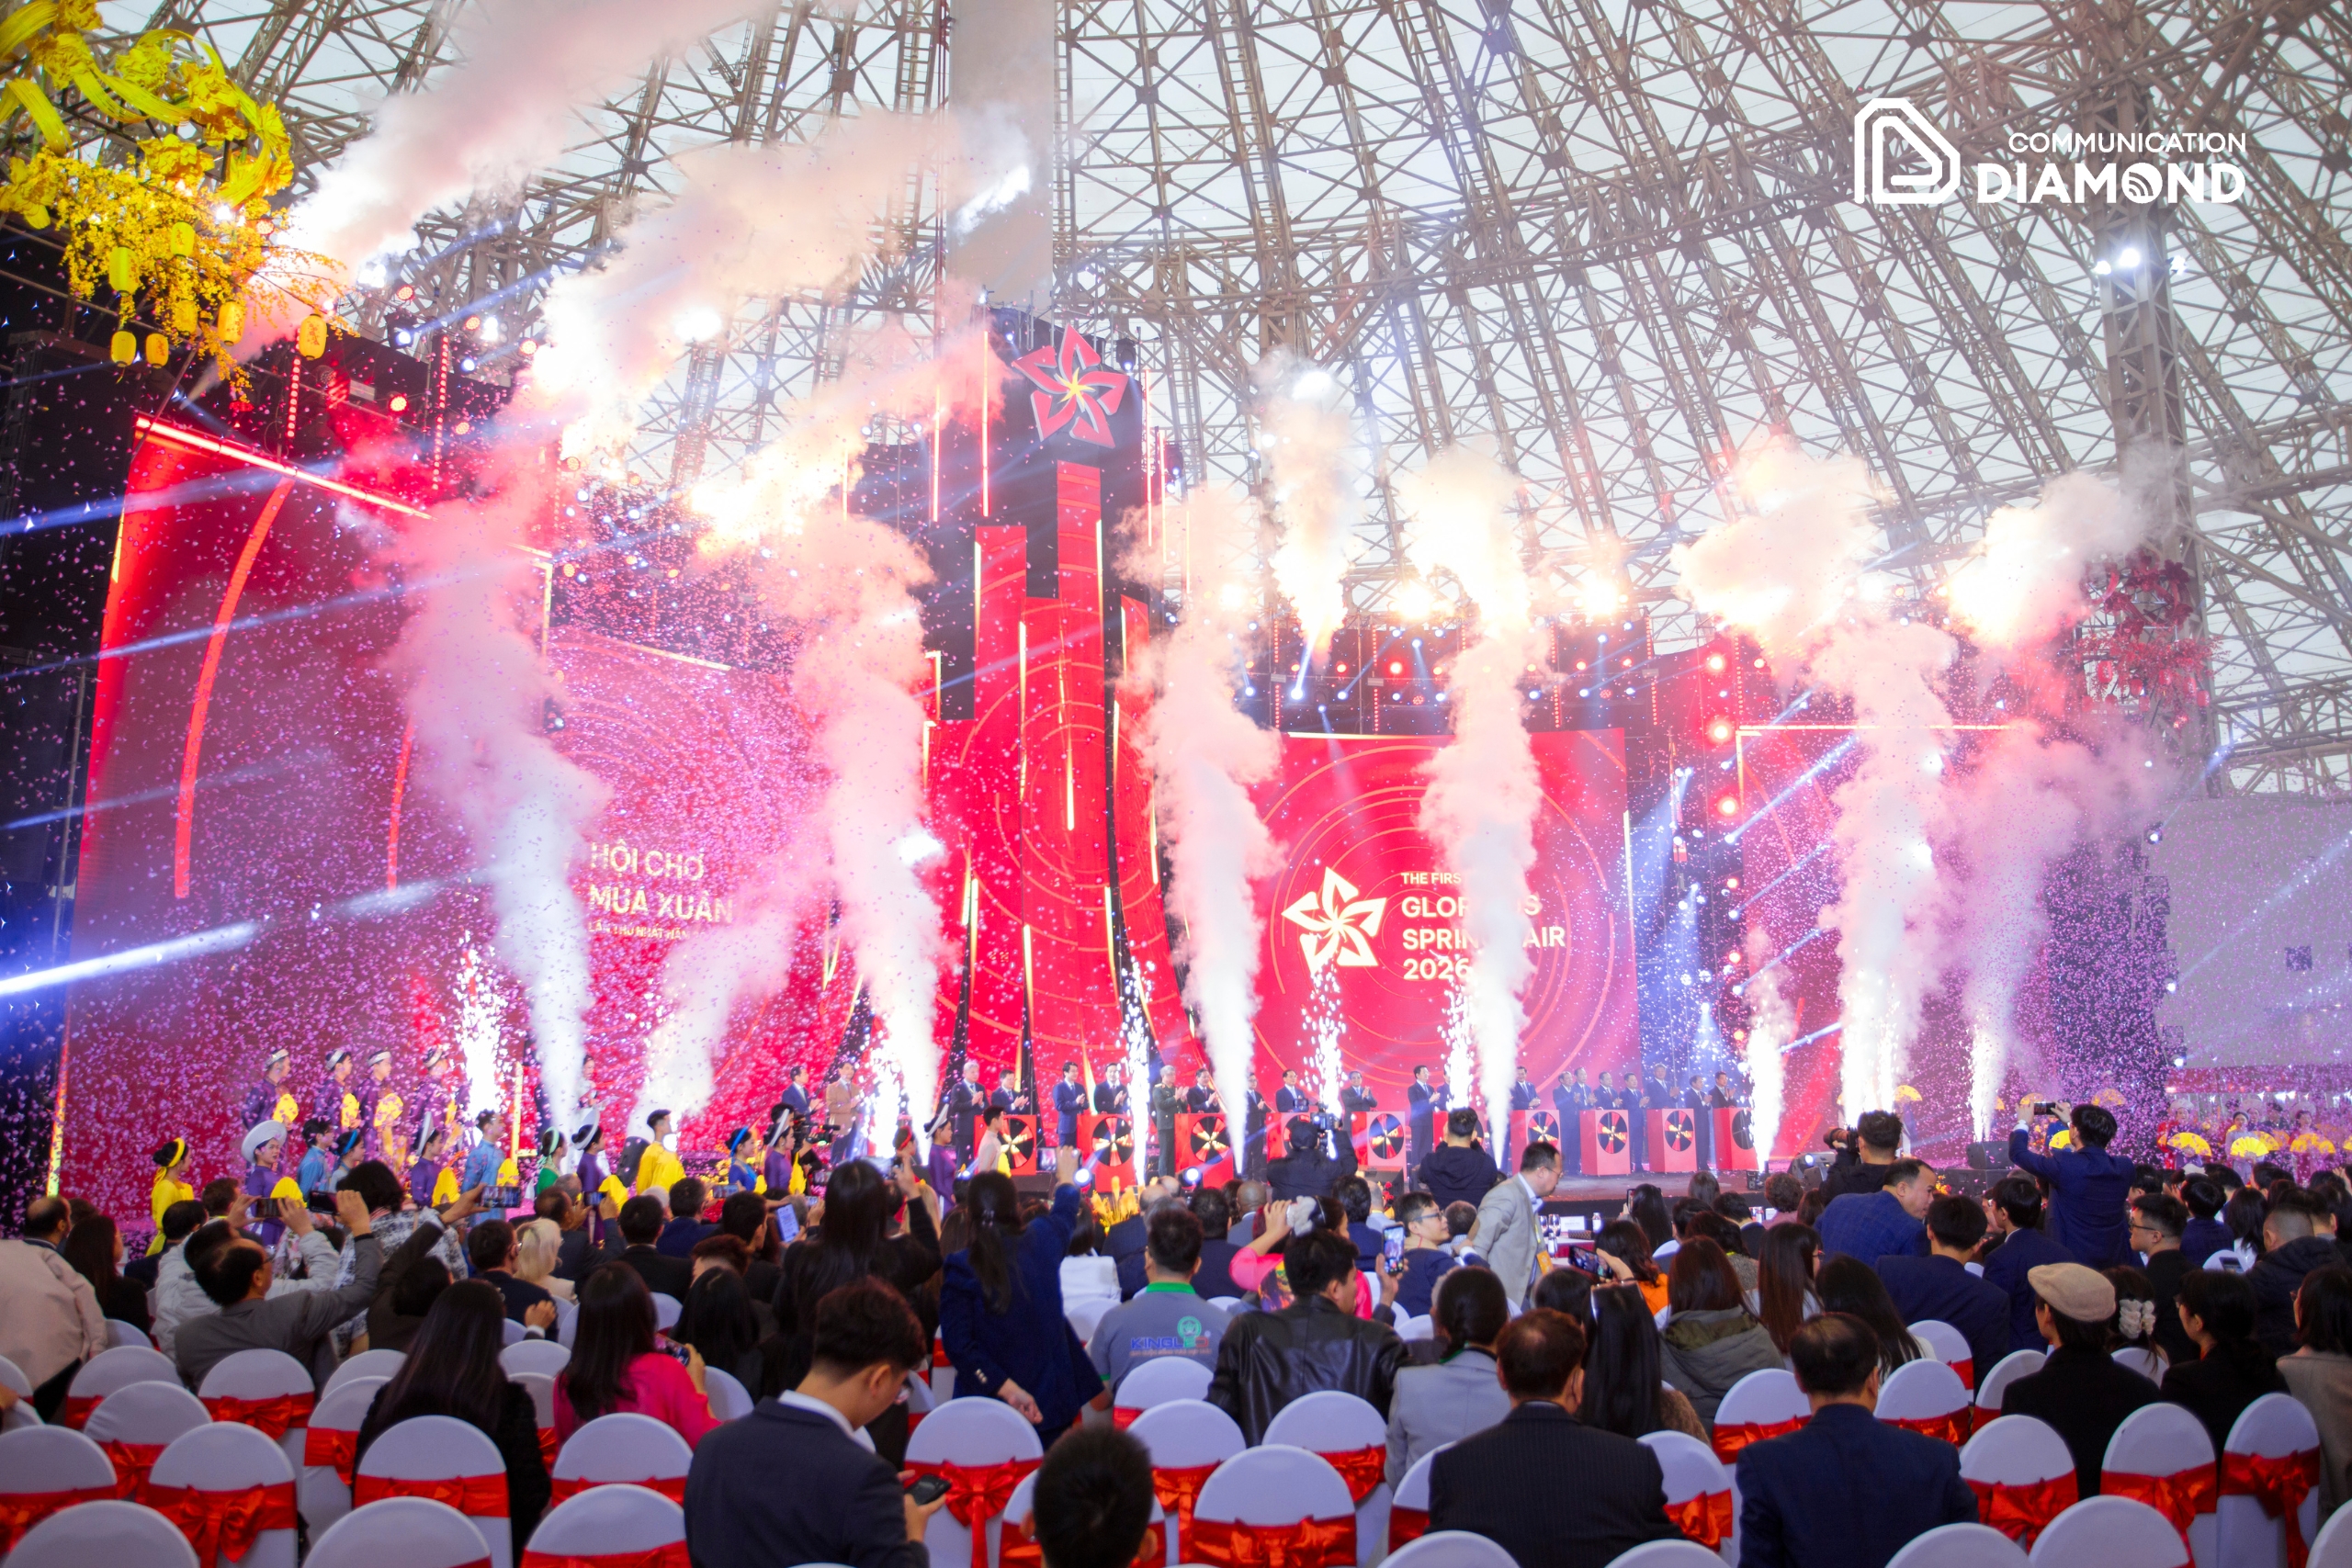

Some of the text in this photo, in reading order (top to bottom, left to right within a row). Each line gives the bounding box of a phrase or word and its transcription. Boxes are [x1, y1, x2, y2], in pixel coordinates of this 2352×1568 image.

[591, 838, 706, 886] HỘI CHỢ
[1400, 873, 1462, 885] THE FIRS
[655, 890, 733, 924] XUÂN
[1402, 927, 1566, 950] SPRIN AIR
[1403, 958, 1471, 981] 2026
